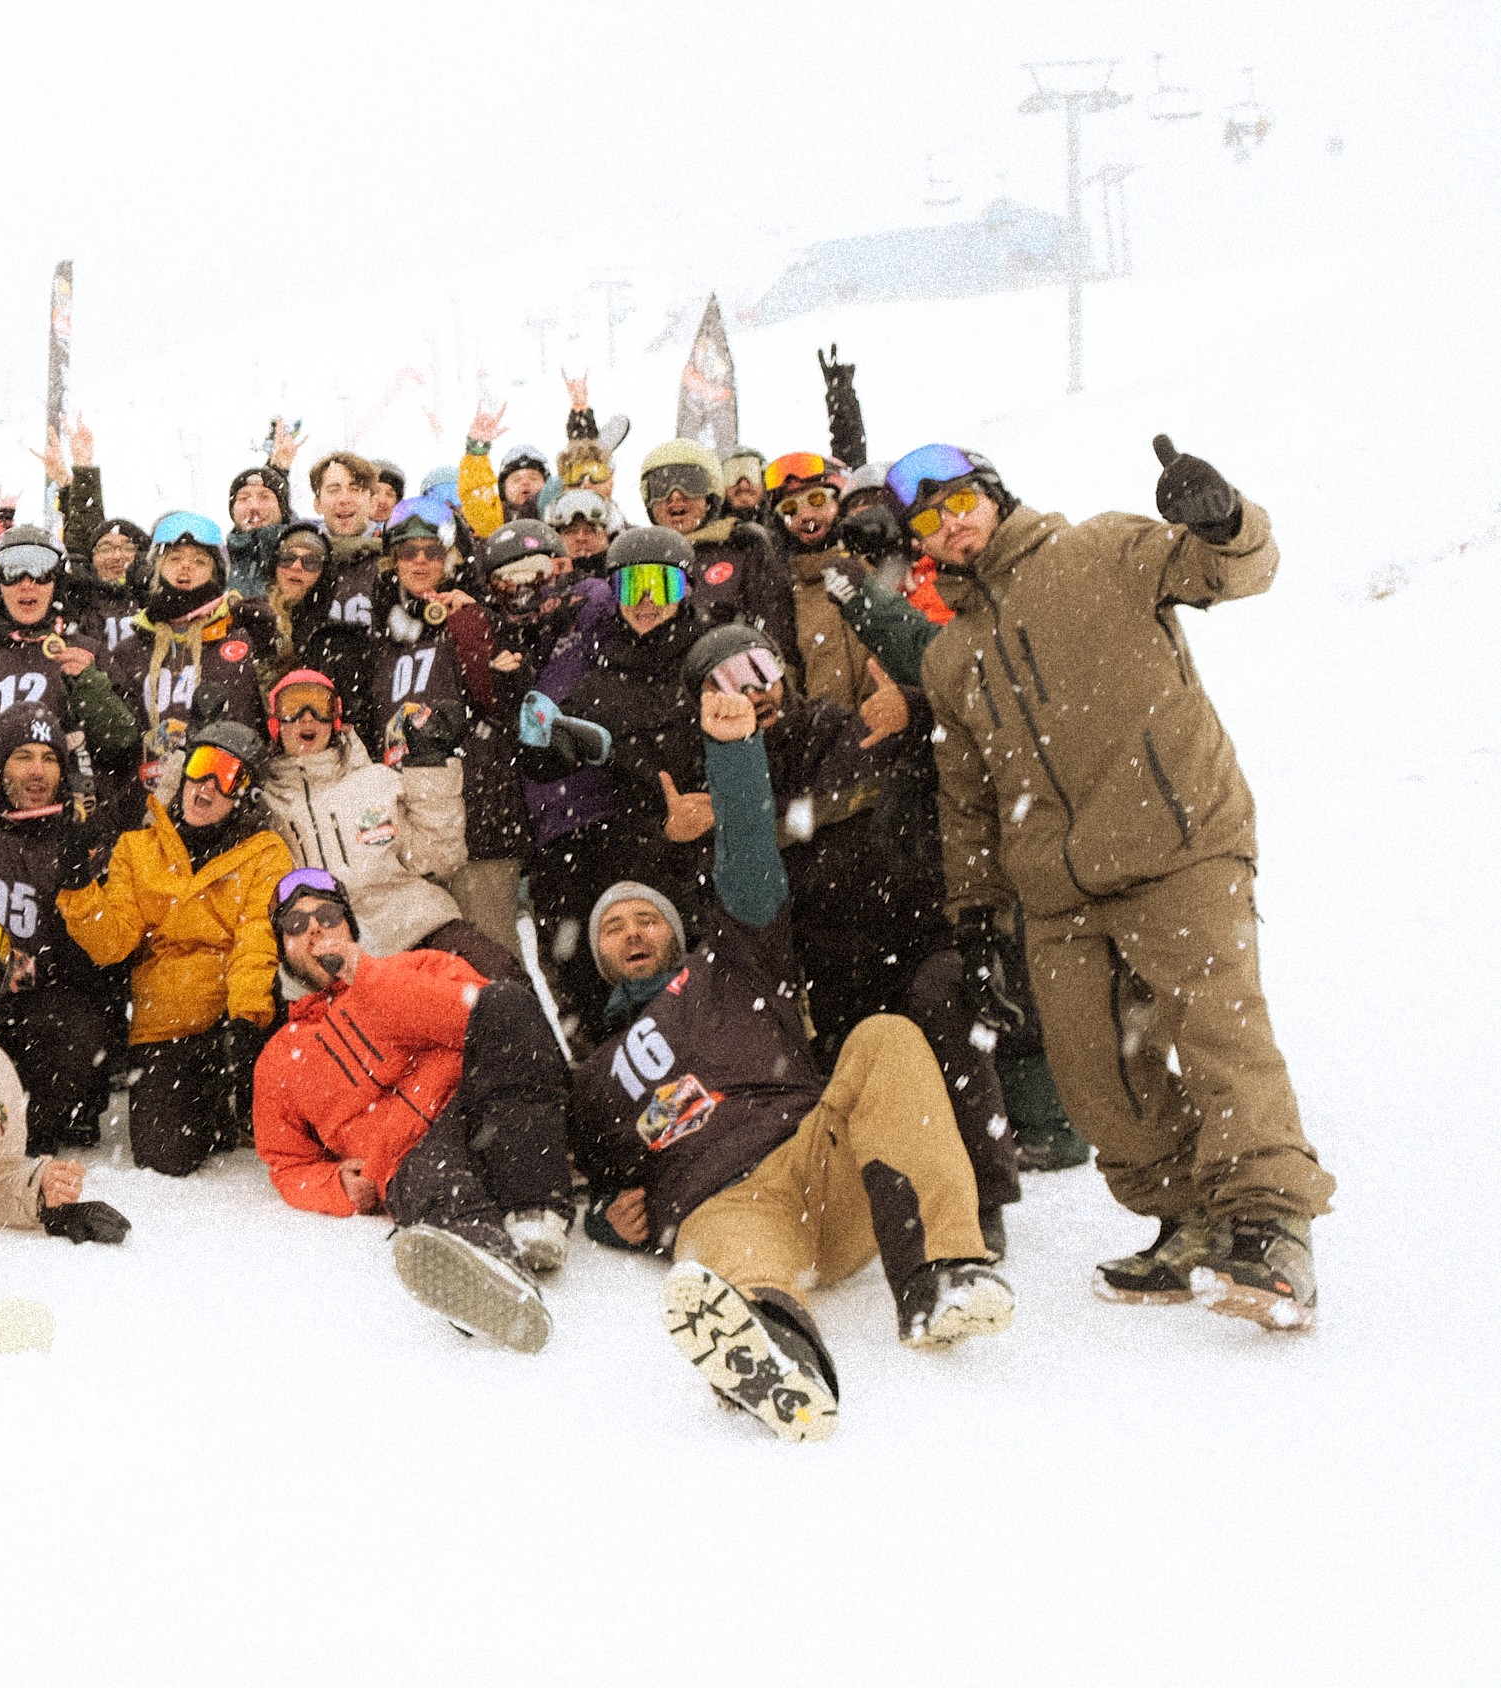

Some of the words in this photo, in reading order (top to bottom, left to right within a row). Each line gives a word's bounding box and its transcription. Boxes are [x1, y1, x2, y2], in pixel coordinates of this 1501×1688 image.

[143, 665, 200, 714] 04
[391, 647, 437, 702] 07
[31, 720, 51, 742] NY
[610, 1016, 675, 1101] 16
